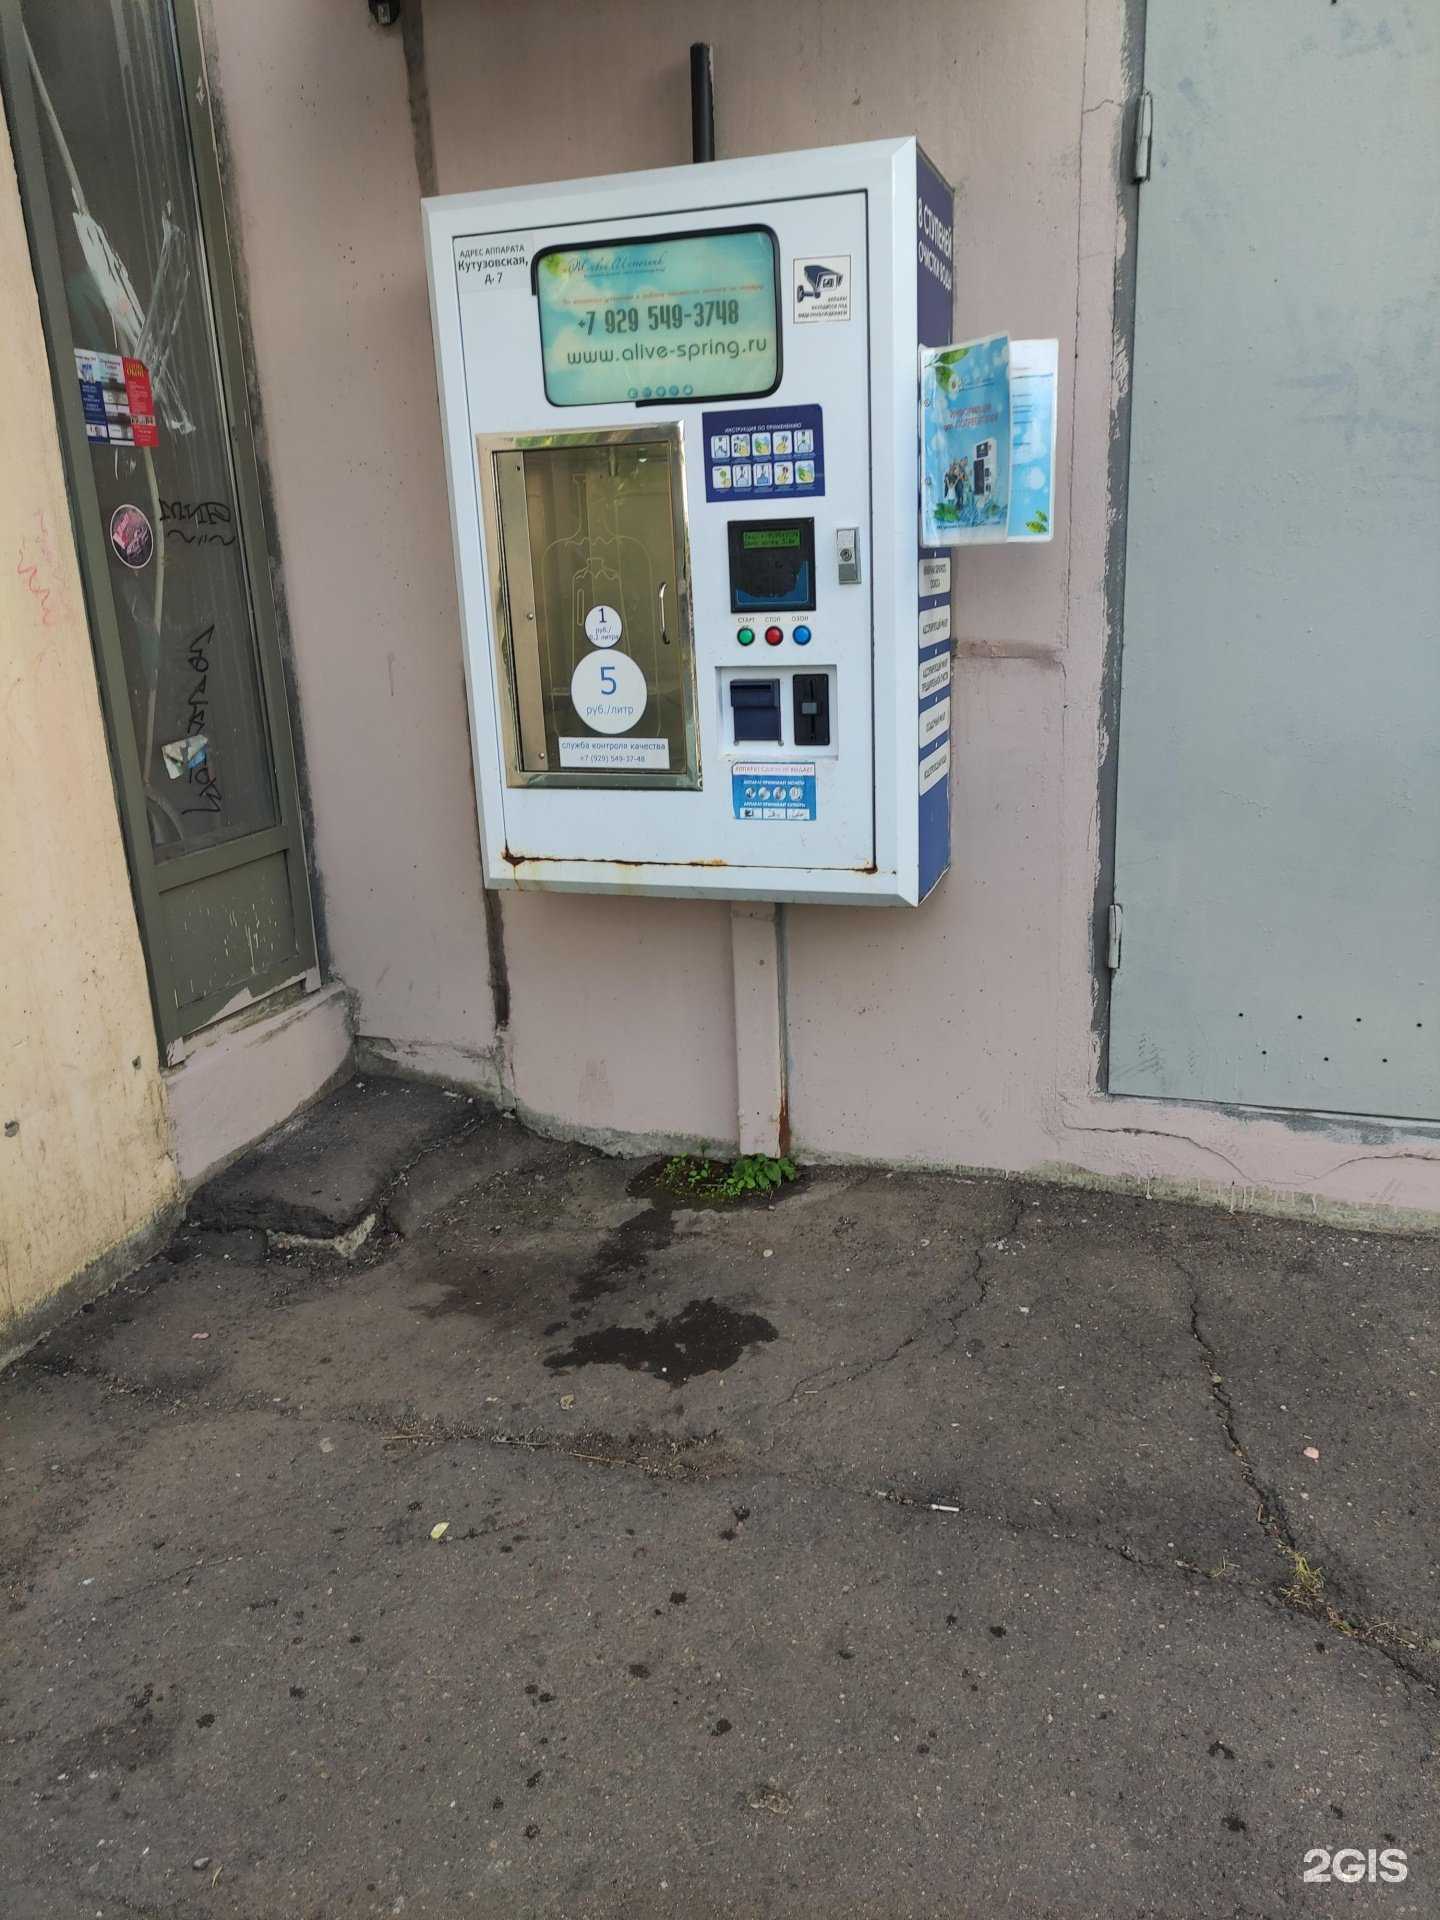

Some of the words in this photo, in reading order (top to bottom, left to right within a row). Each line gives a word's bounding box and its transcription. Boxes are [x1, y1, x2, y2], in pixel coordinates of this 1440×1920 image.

[918, 197, 923, 229] 8
[460, 248, 484, 258] АДРЕС
[486, 244, 525, 256] АППАРАТА
[458, 256, 529, 273] Кутузовская,
[496, 272, 503, 284] 7
[578, 311, 596, 336] +7
[604, 307, 639, 335] 929
[647, 299, 739, 331] 549-3748
[567, 337, 768, 366] www.alive-spring.ru
[598, 608, 607, 623] 1
[599, 666, 618, 696] 5
[586, 704, 634, 717] руб./литр
[561, 741, 590, 752] служба
[591, 742, 628, 752] контроля
[629, 742, 666, 752] качества
